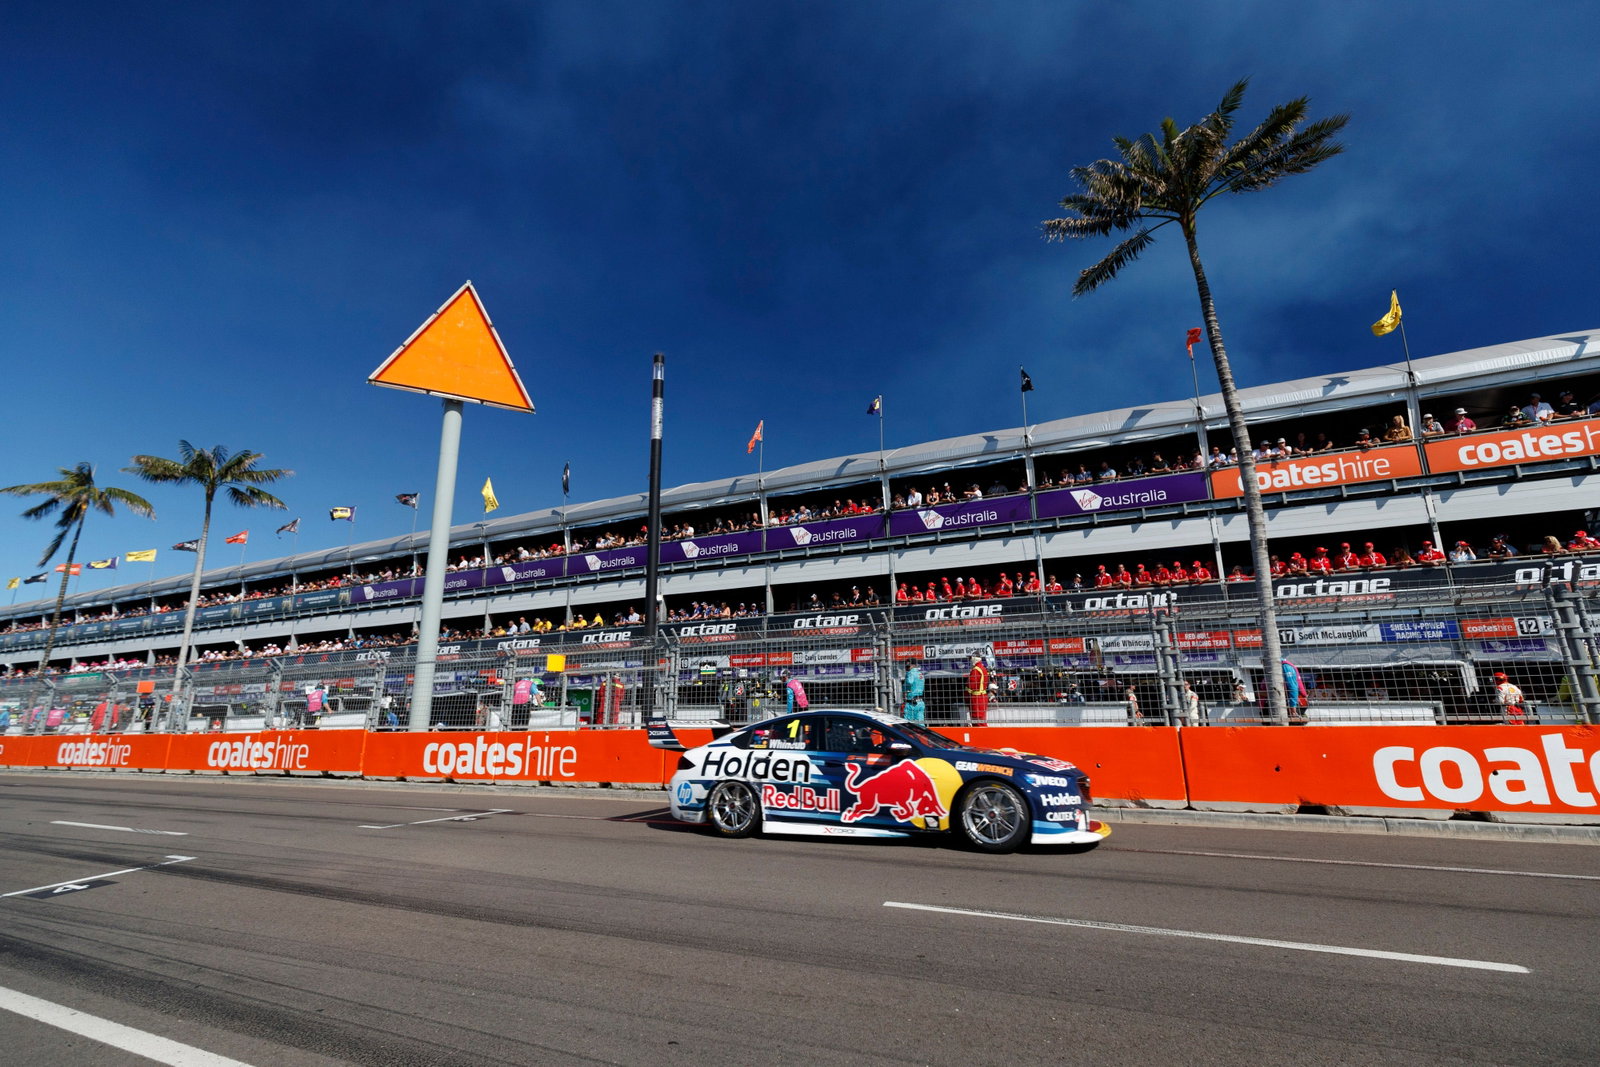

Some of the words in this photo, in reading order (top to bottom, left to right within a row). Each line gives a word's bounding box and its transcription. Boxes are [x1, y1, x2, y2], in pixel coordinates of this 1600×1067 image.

[1078, 493, 1097, 508] Virgin
[1103, 490, 1167, 507] australia
[944, 511, 997, 527] australia
[811, 528, 857, 544] australia
[700, 543, 739, 557] australia
[601, 556, 635, 570] australia
[515, 567, 546, 580] australia
[373, 588, 398, 599] australia
[1277, 578, 1391, 598] octane
[926, 604, 1003, 621] octane
[794, 615, 859, 629] octane
[968, 618, 1002, 626] EVENTS
[1467, 624, 1512, 634] coateshire
[1519, 619, 1536, 633] 12
[582, 631, 631, 643] octane
[680, 623, 737, 637] octane
[1280, 631, 1294, 643] 17
[1299, 631, 1320, 641] Scott
[1321, 630, 1368, 641] McLaughlin
[1424, 630, 1443, 640] TEAM
[497, 638, 540, 651] octane
[1101, 640, 1120, 649] Jamie
[1122, 639, 1151, 650] Whincup
[925, 647, 935, 659] 97
[938, 646, 954, 657] Shane
[955, 648, 965, 656] van
[787, 719, 801, 738] 1
[57, 737, 132, 765] coateshire
[769, 739, 806, 750] Whincup
[208, 736, 309, 769] coateshire
[423, 735, 577, 777] coateshire
[701, 751, 810, 783] Holden
[955, 761, 1014, 777] GEARWRENCH
[1372, 733, 1600, 808] coat
[679, 784, 692, 804] hp
[763, 785, 800, 809] Red
[801, 787, 840, 813] Bull
[1040, 793, 1082, 807] Holden
